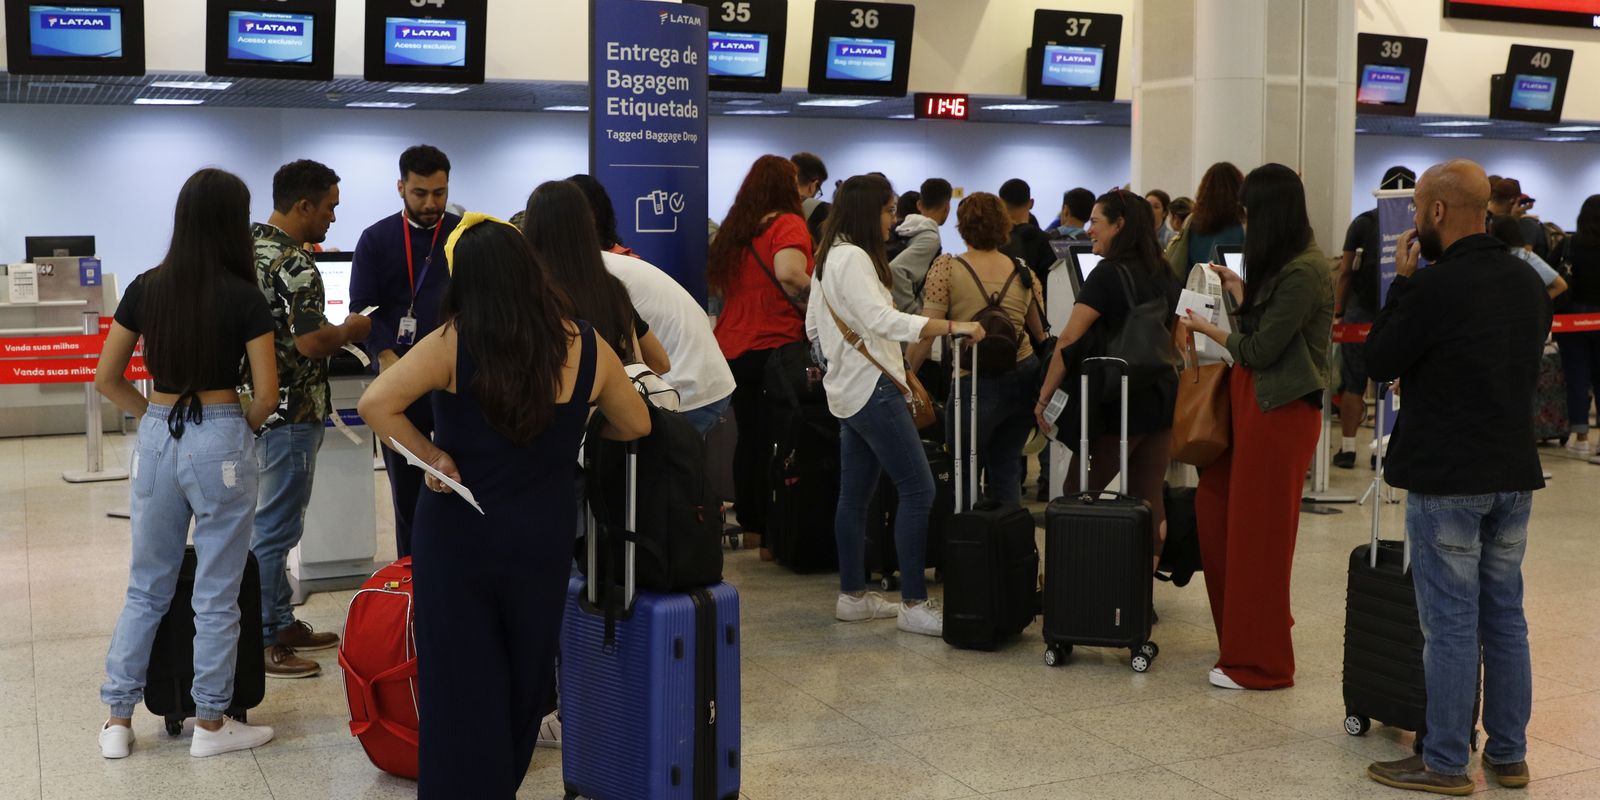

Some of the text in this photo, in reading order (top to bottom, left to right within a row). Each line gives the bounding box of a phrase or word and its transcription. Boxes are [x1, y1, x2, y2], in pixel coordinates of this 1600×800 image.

[721, 2, 751, 22] 35
[850, 8, 879, 29] 36
[60, 18, 104, 26] LATAM
[670, 14, 701, 26] LATAM
[1065, 17, 1092, 36] 37
[256, 23, 297, 32] LATAM
[411, 29, 451, 37] LATAM
[238, 36, 303, 46] Acesso exclusivo
[720, 42, 754, 50] LATAM
[607, 42, 698, 68] Entrega de
[849, 47, 882, 55] LATAM
[1380, 41, 1402, 58] 39
[1062, 55, 1092, 63] LATAM
[1530, 52, 1551, 69] 40
[607, 69, 689, 95] Bagagem
[607, 97, 698, 122] Etiquetada
[928, 98, 965, 116] 11:46
[606, 129, 698, 144] Tagged Baggage Drop
[4, 344, 31, 352] Venda
[53, 342, 79, 350] milhas
[13, 367, 97, 376] Venda suas milha
